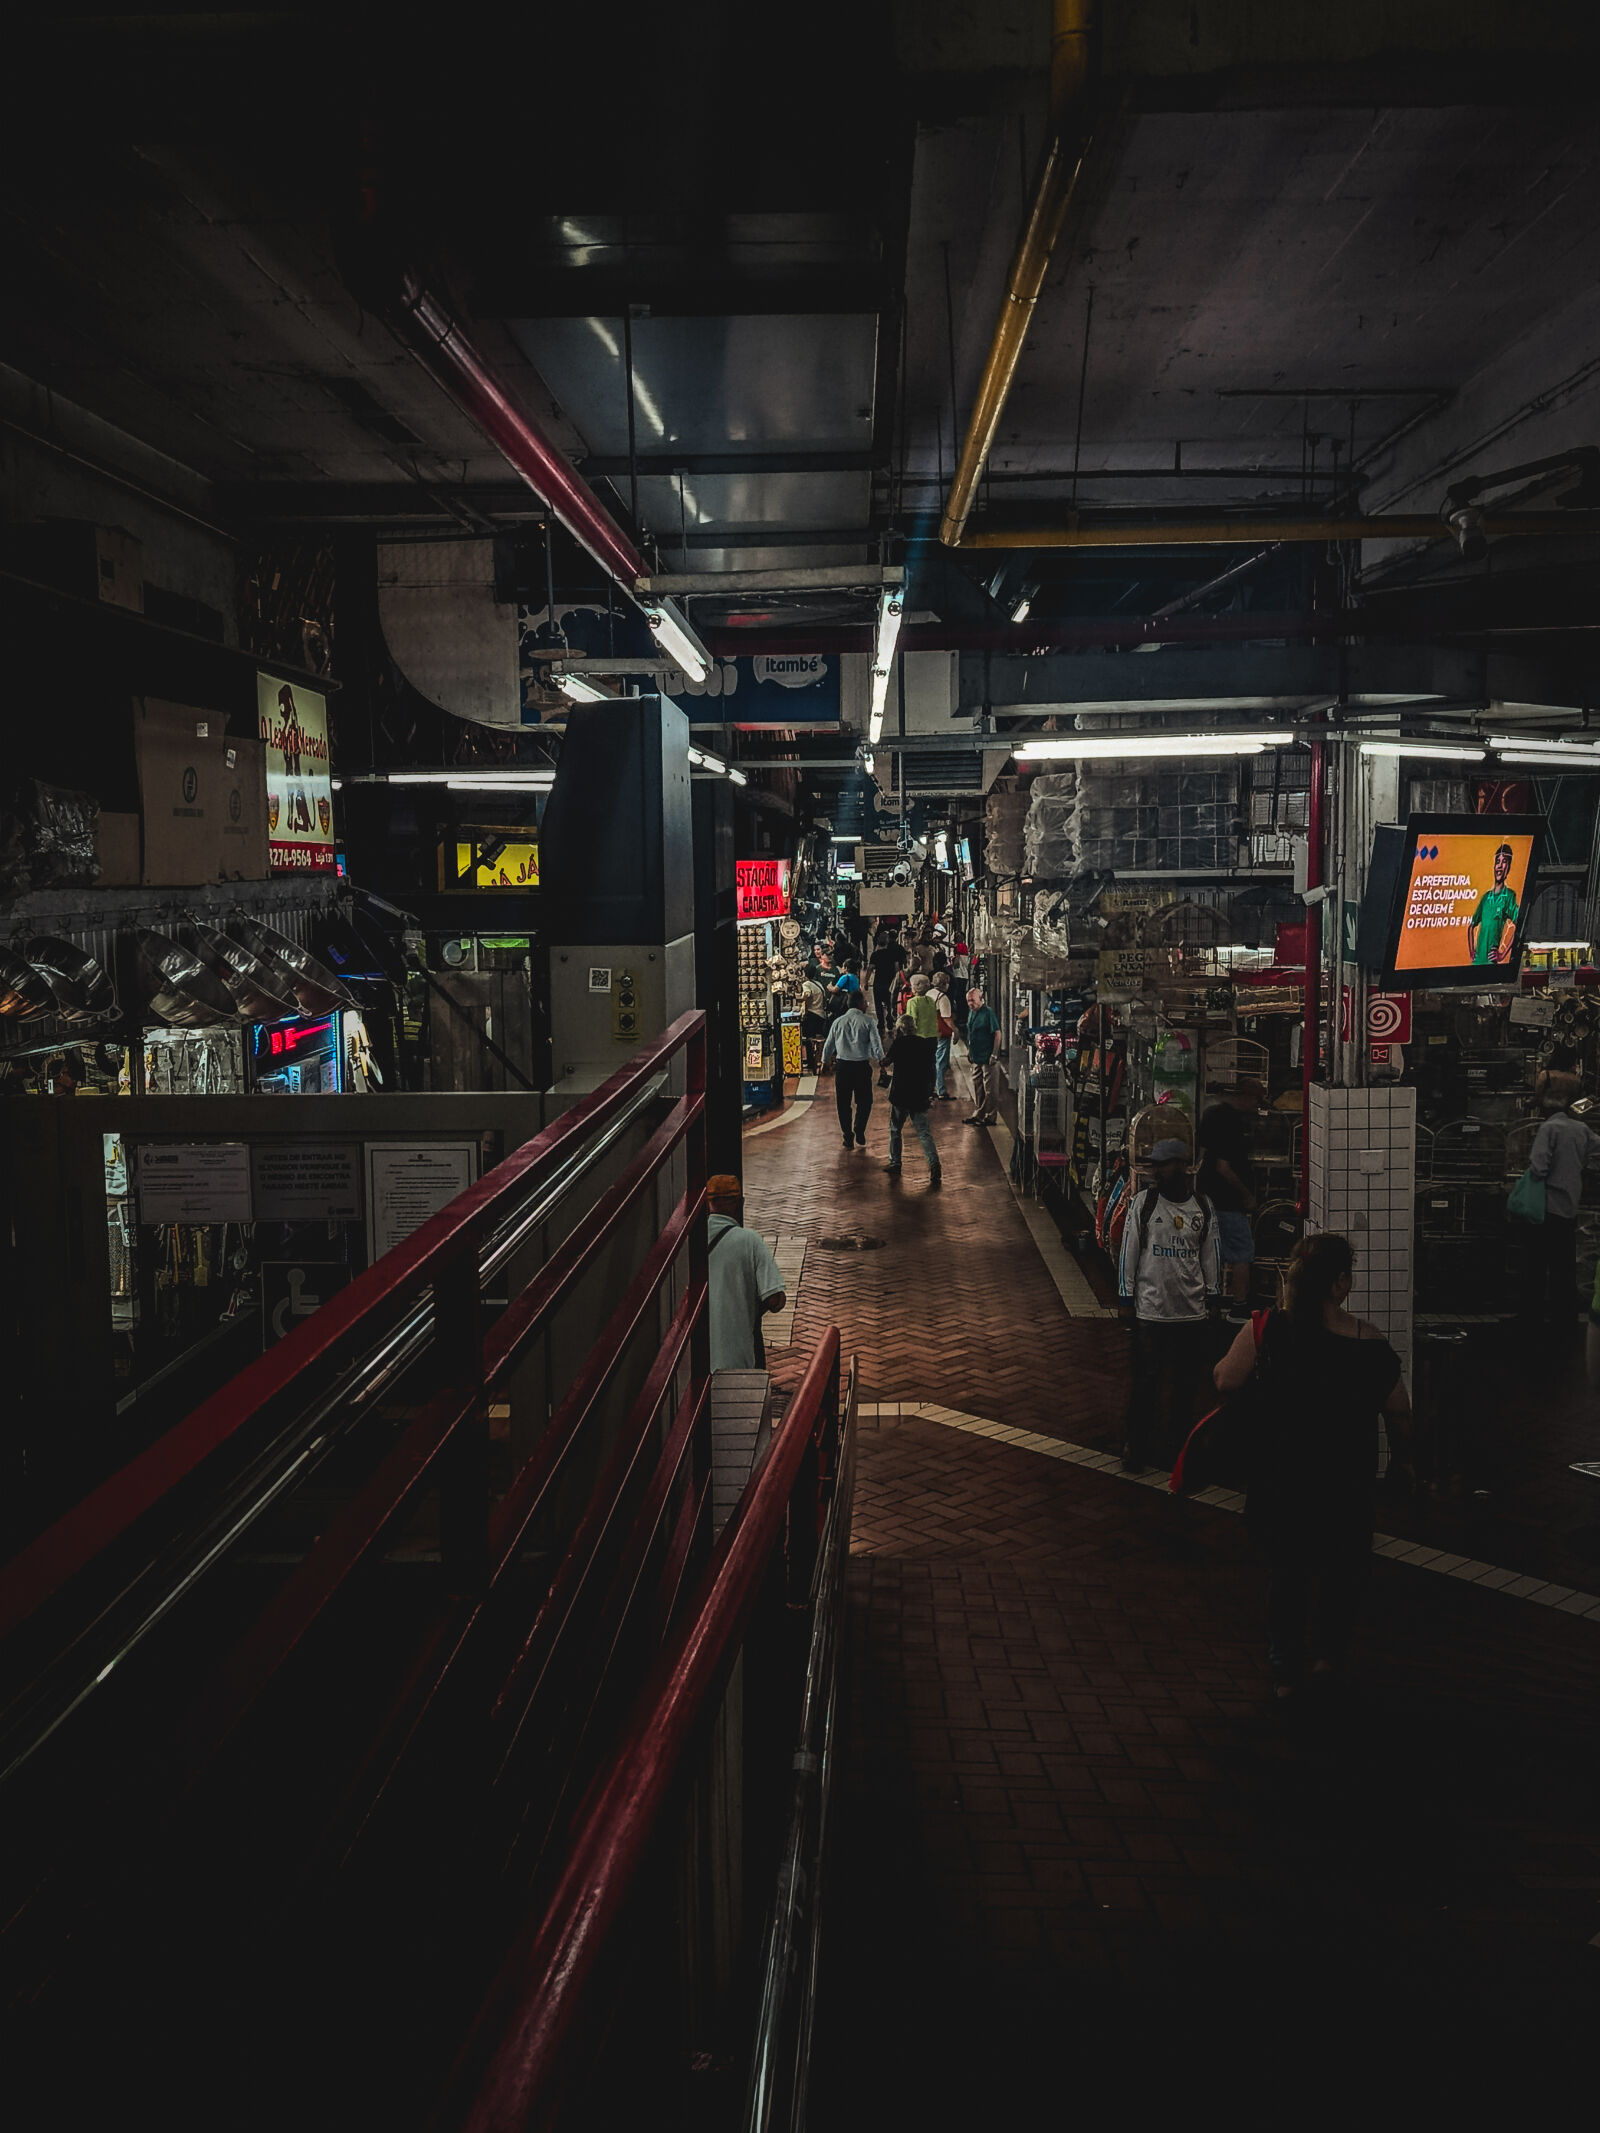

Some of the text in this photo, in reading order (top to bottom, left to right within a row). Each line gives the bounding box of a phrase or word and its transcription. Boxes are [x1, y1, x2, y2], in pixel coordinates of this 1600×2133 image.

[766, 654, 818, 674] itambé
[297, 724, 327, 761] Mercado
[516, 853, 540, 883] JÁ
[1414, 874, 1471, 887] A PREFEITURA
[1411, 886, 1478, 901] ESTÁ CUIDANDO
[1409, 899, 1455, 915] DE QUEM É
[1407, 918, 1415, 928] O
[1415, 916, 1449, 929] FUTURO
[1449, 916, 1461, 926] DE
